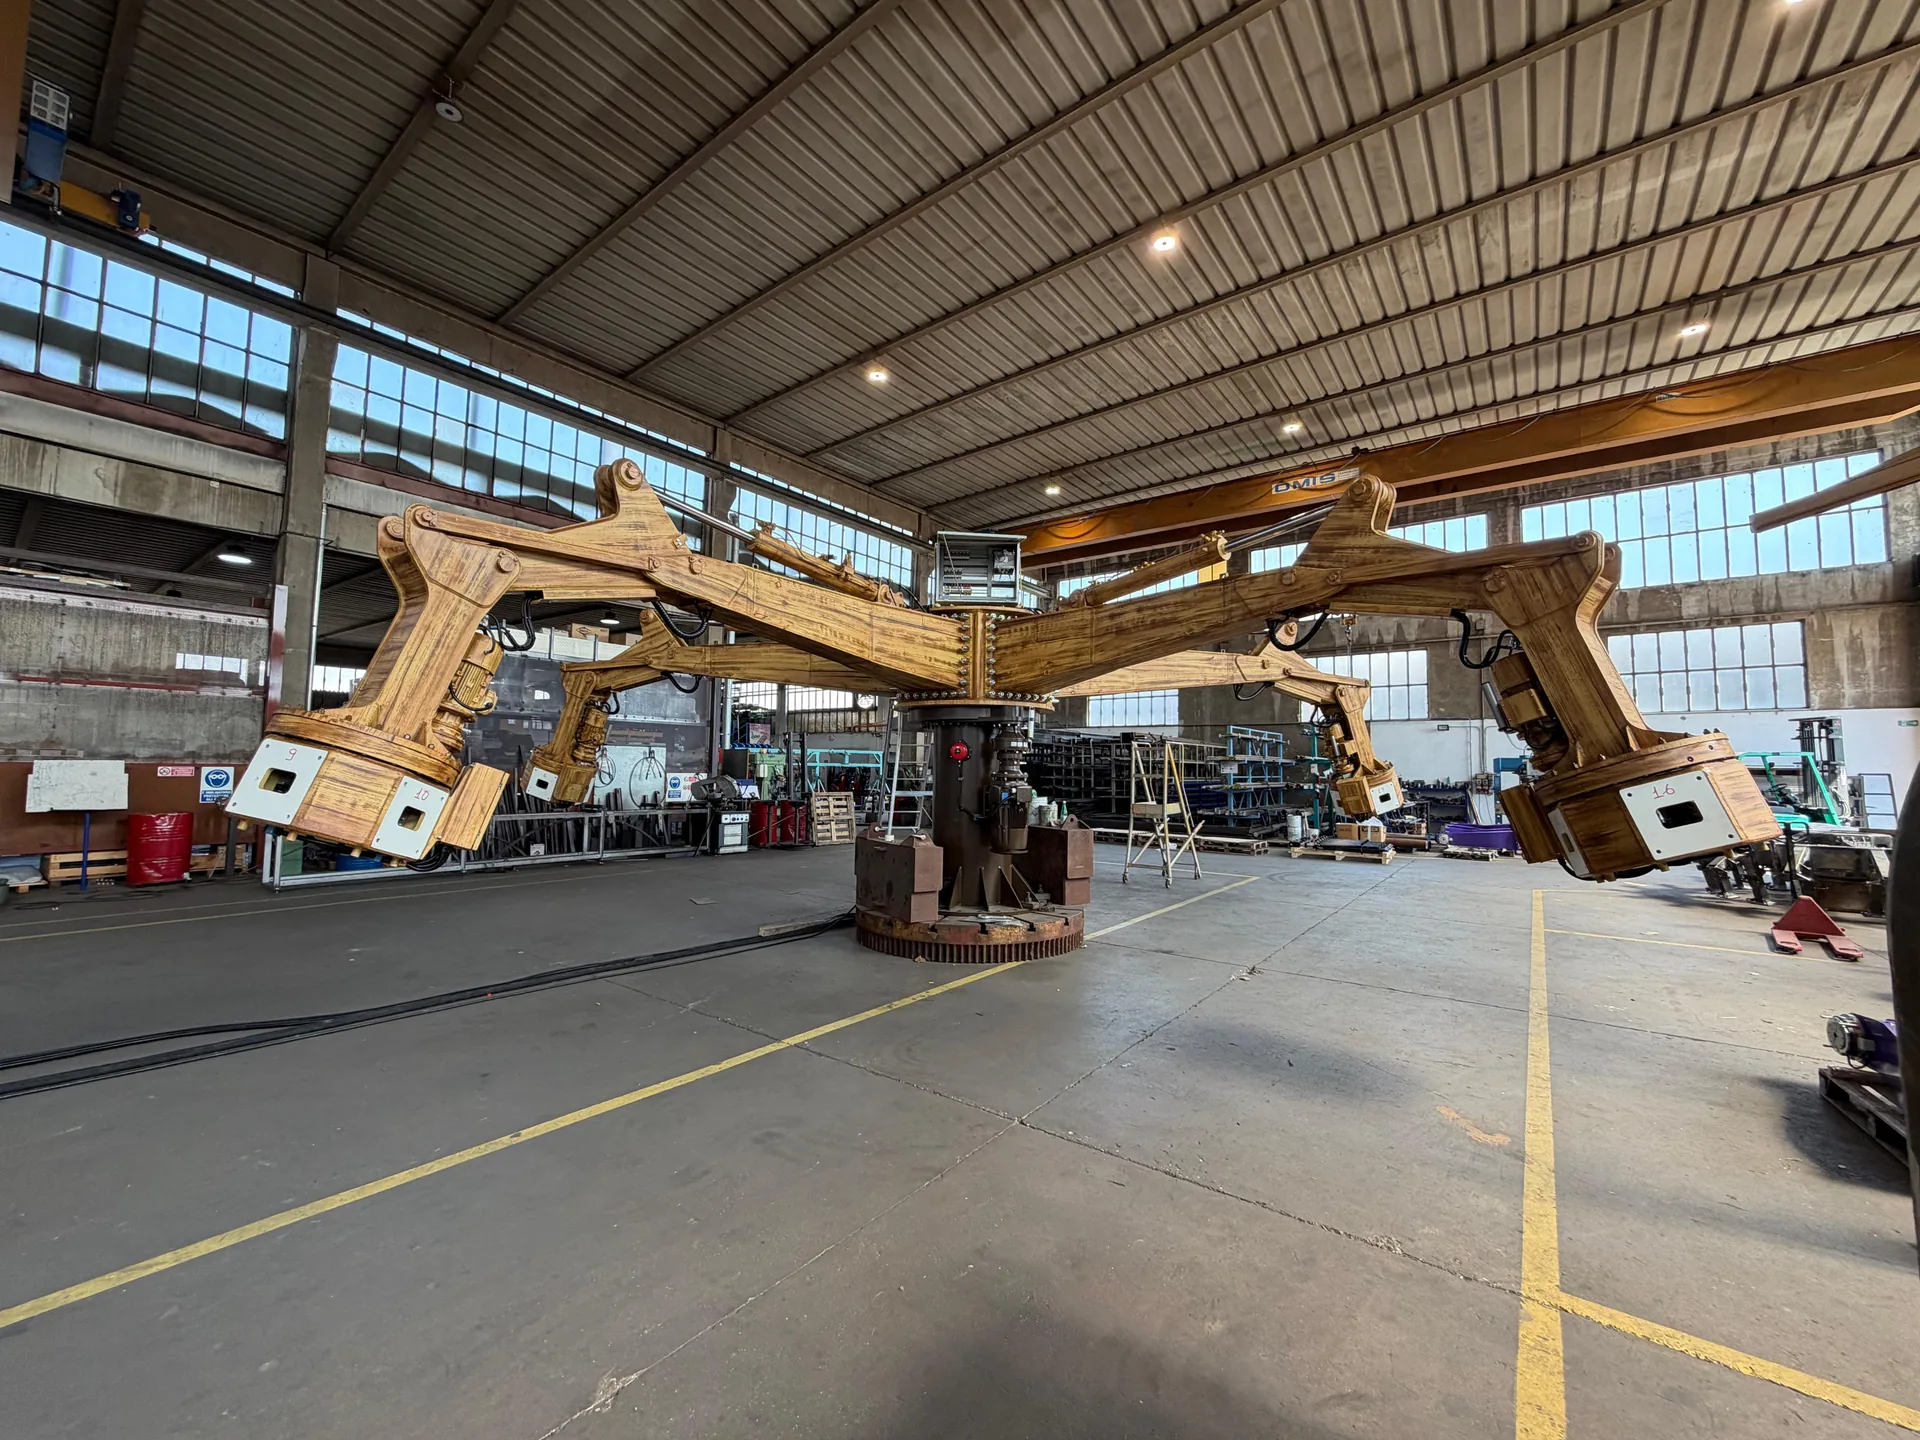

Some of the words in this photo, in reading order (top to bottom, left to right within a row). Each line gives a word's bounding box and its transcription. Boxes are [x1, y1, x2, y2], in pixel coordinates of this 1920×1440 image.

[1274, 473, 1336, 493] OMIS
[285, 748, 297, 761] 9
[414, 787, 430, 801] 10
[1652, 783, 1676, 800] 16
